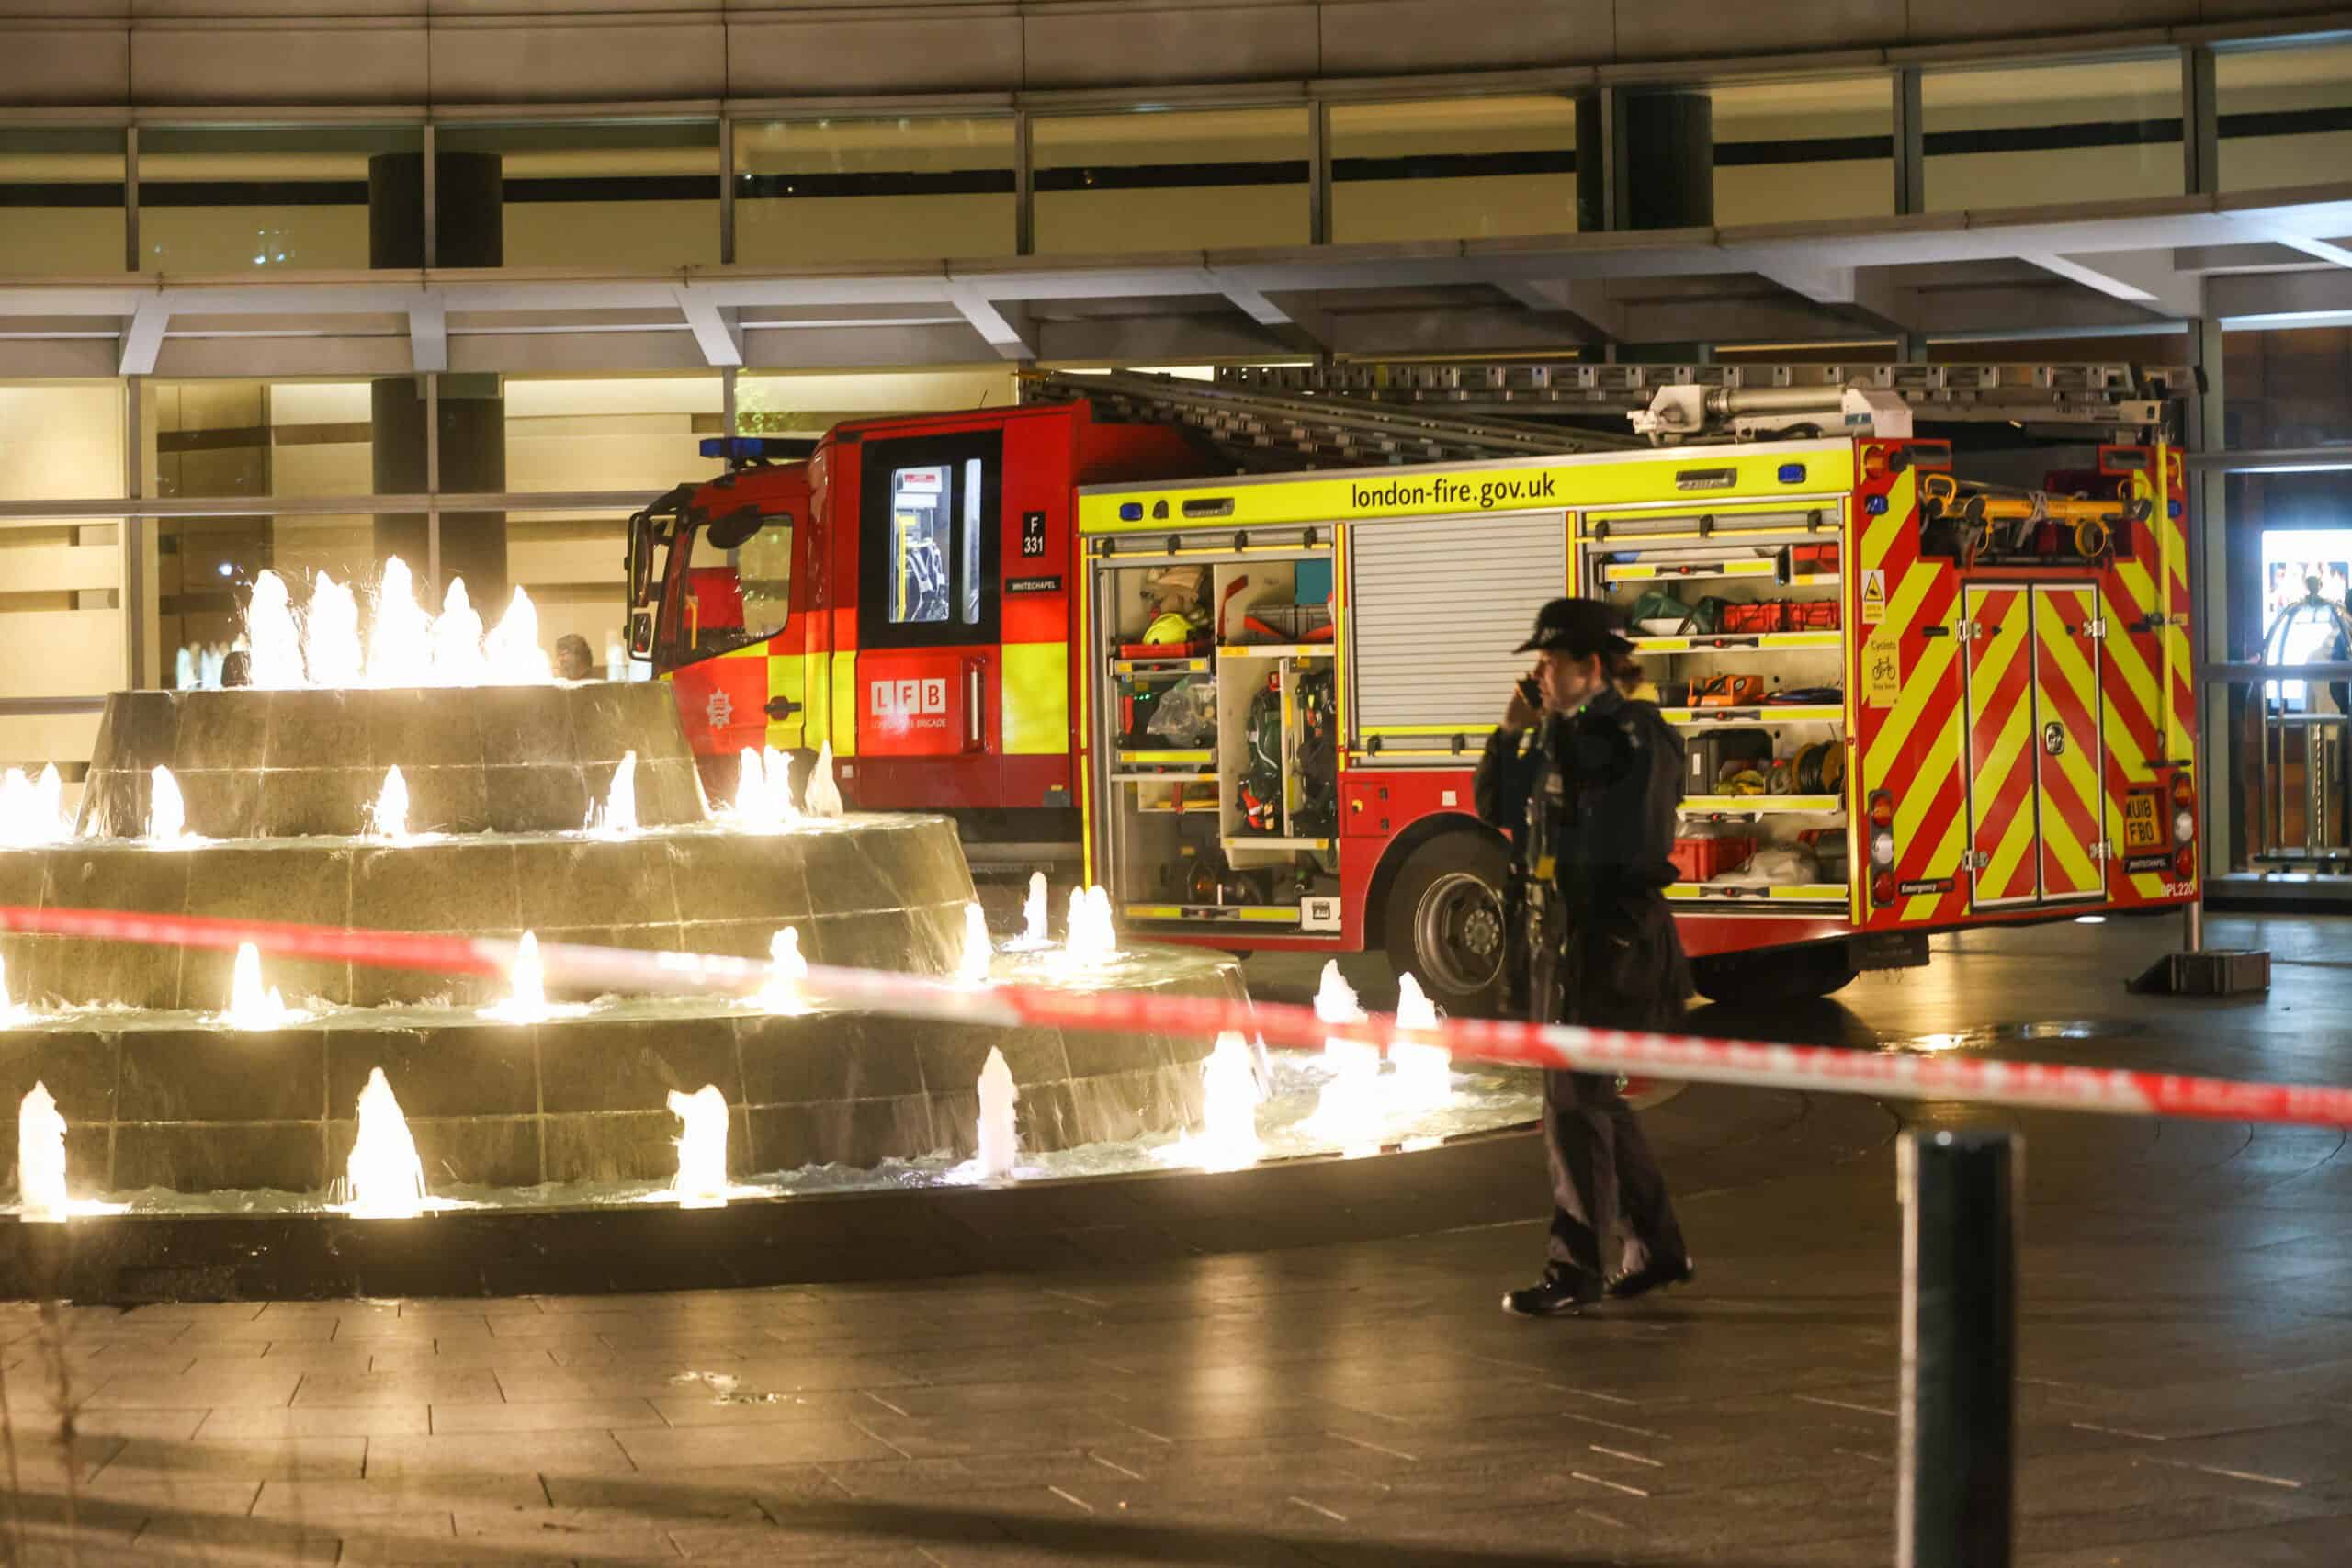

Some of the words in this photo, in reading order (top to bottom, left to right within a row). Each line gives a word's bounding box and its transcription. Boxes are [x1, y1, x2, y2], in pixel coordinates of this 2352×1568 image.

[1352, 472, 1555, 508] london-fire.gov.uk
[1030, 516, 1039, 533] F
[1023, 536, 1044, 553] 331
[1012, 581, 1056, 591] WHITECHAPEL
[876, 682, 942, 710] LFB
